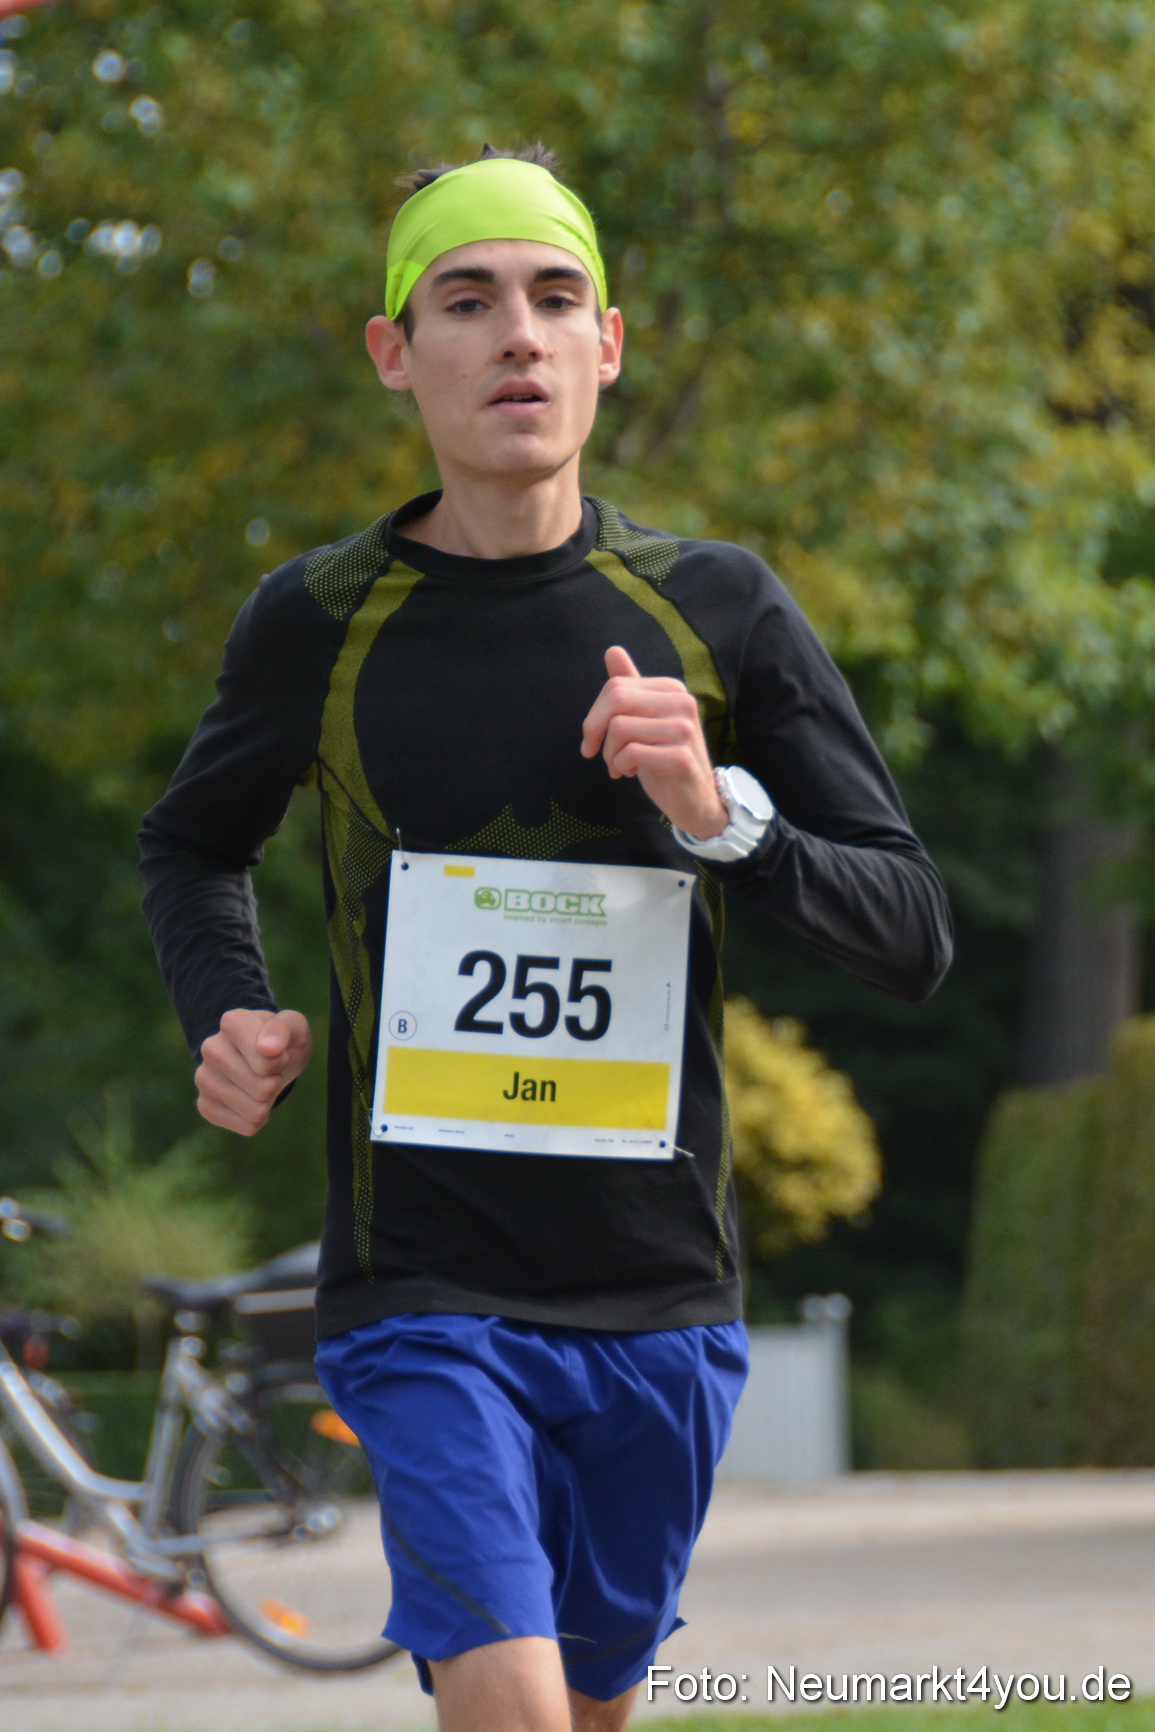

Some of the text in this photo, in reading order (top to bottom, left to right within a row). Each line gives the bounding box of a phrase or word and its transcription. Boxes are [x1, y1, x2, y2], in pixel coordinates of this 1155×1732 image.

[504, 889, 607, 917] BOCK
[503, 913, 535, 922] inspired
[537, 915, 547, 923] by
[454, 949, 612, 1042] 255
[397, 1019, 408, 1033] B
[503, 1072, 557, 1102] Jan
